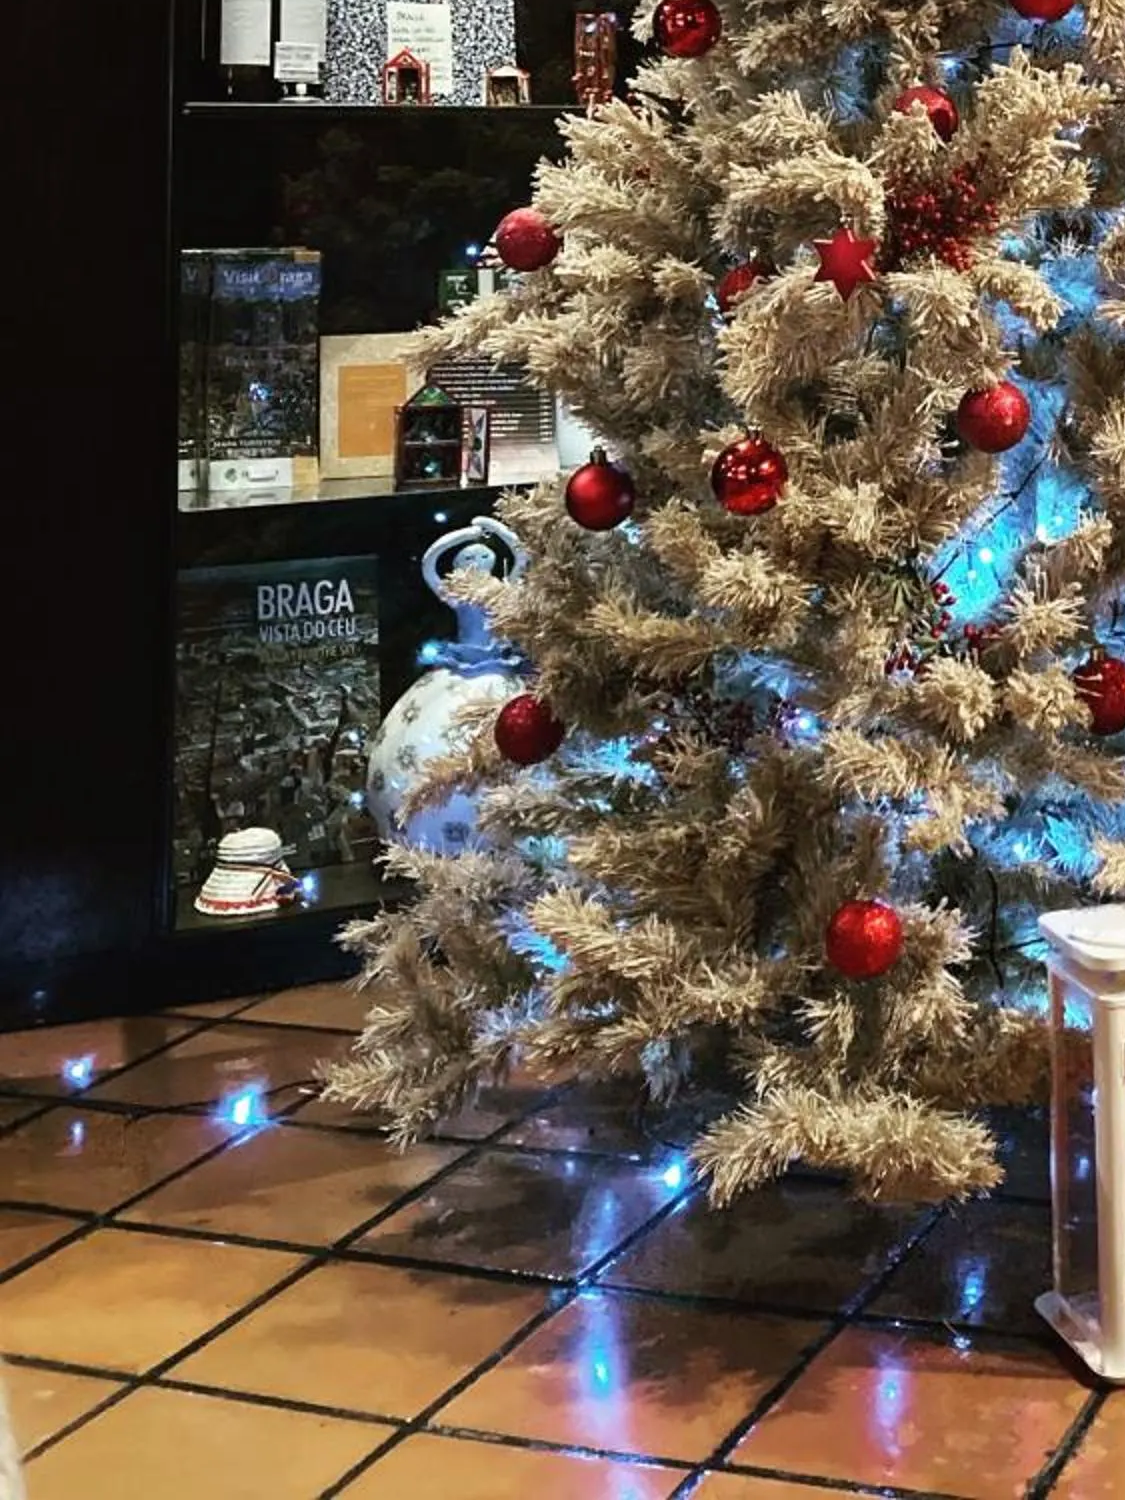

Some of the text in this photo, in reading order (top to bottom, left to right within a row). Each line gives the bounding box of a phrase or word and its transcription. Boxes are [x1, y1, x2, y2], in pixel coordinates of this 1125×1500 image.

[257, 578, 355, 620] BRAGA
[259, 623, 300, 642] VISTA
[303, 620, 326, 639] DO
